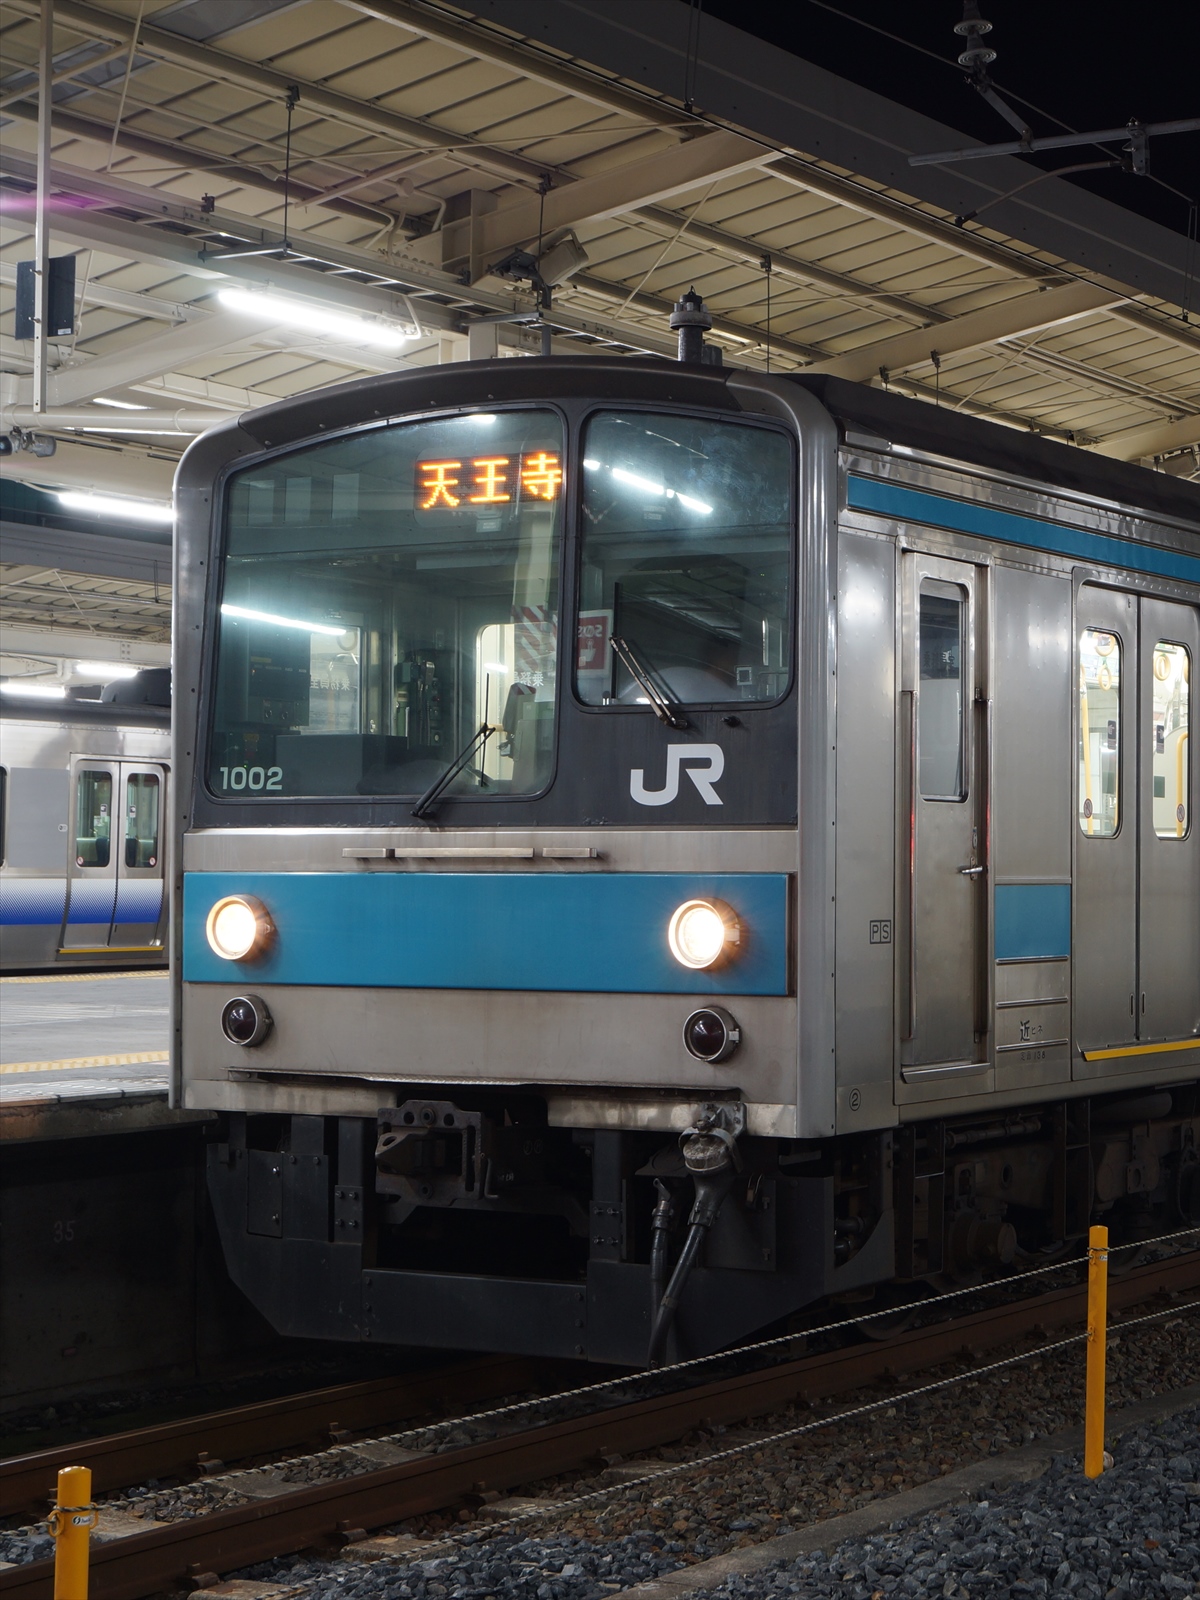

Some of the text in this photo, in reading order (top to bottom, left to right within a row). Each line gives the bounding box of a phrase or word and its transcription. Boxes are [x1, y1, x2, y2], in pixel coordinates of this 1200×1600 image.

[421, 453, 562, 508] 天王寺
[220, 766, 283, 790] 1002
[630, 743, 725, 806] JR
[872, 924, 890, 940] PS
[53, 1220, 76, 1243] 35
